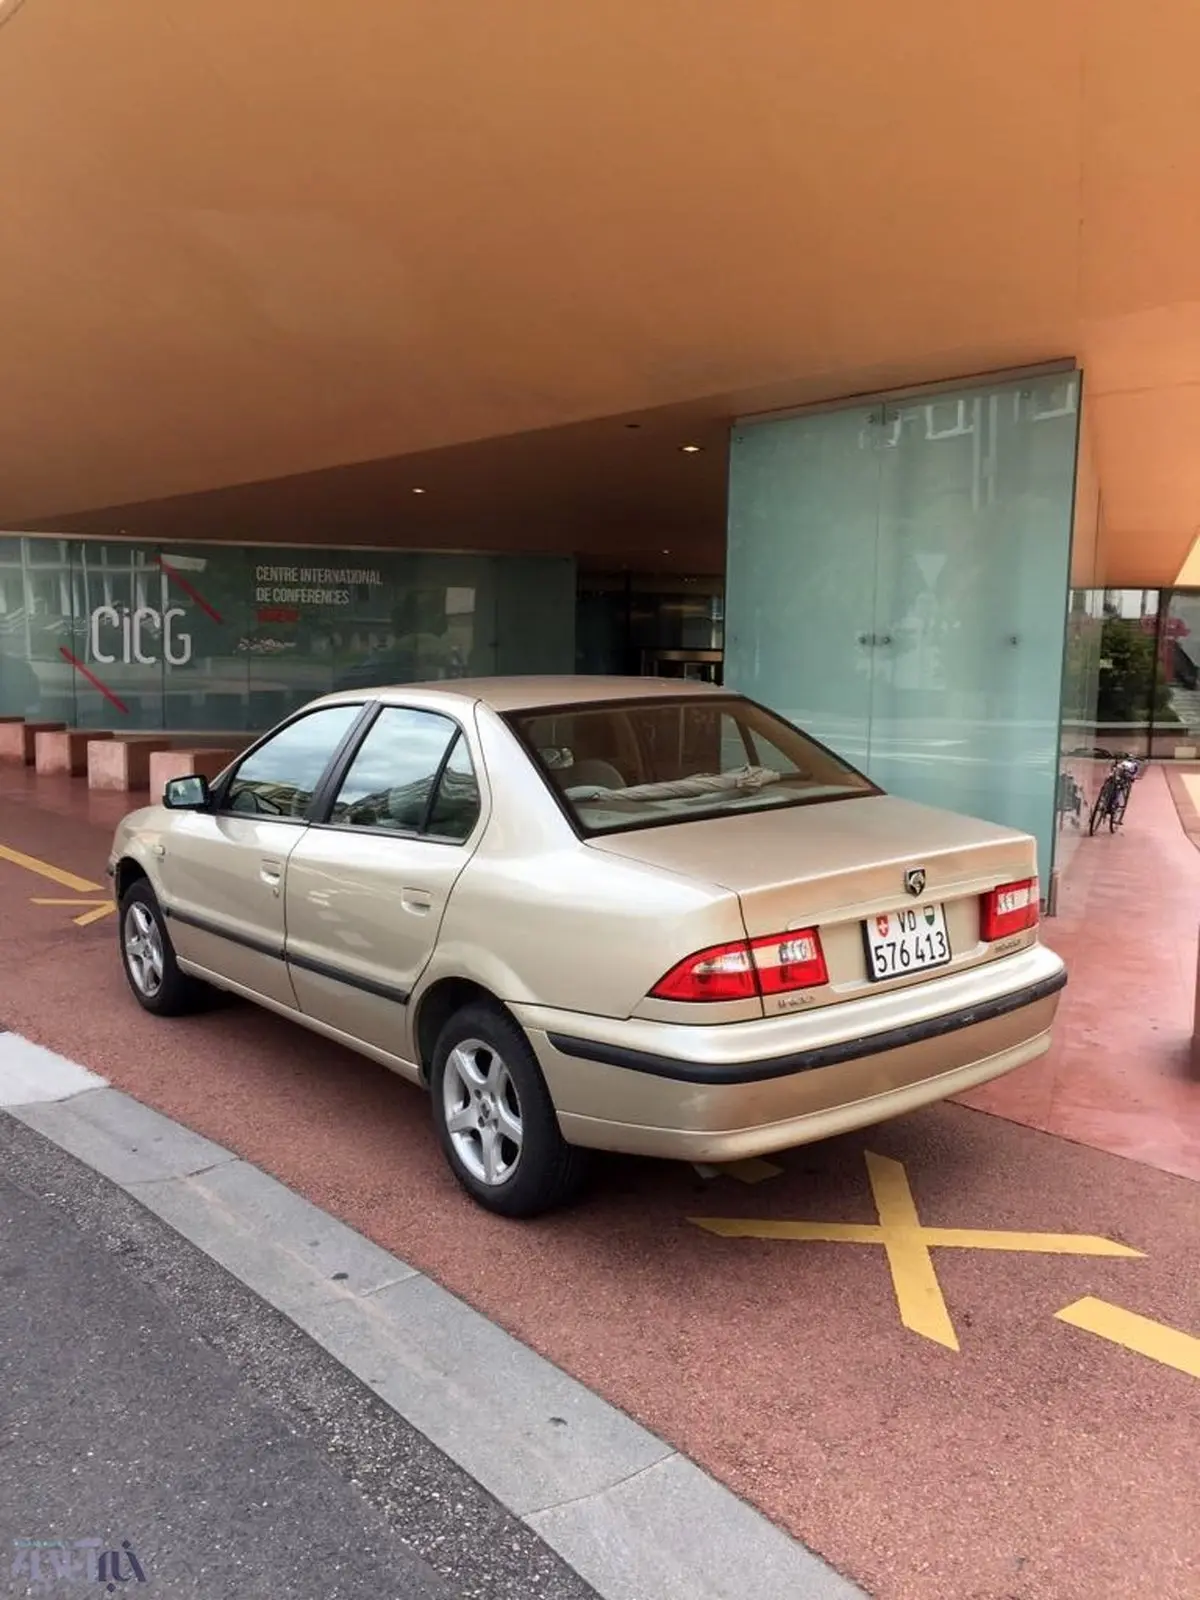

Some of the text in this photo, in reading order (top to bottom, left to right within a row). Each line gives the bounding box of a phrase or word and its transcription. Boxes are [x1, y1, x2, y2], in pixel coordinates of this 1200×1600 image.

[255, 565, 382, 585] CENTRE INTERNATIONAL
[255, 587, 271, 603] DE
[897, 910, 917, 933] VD
